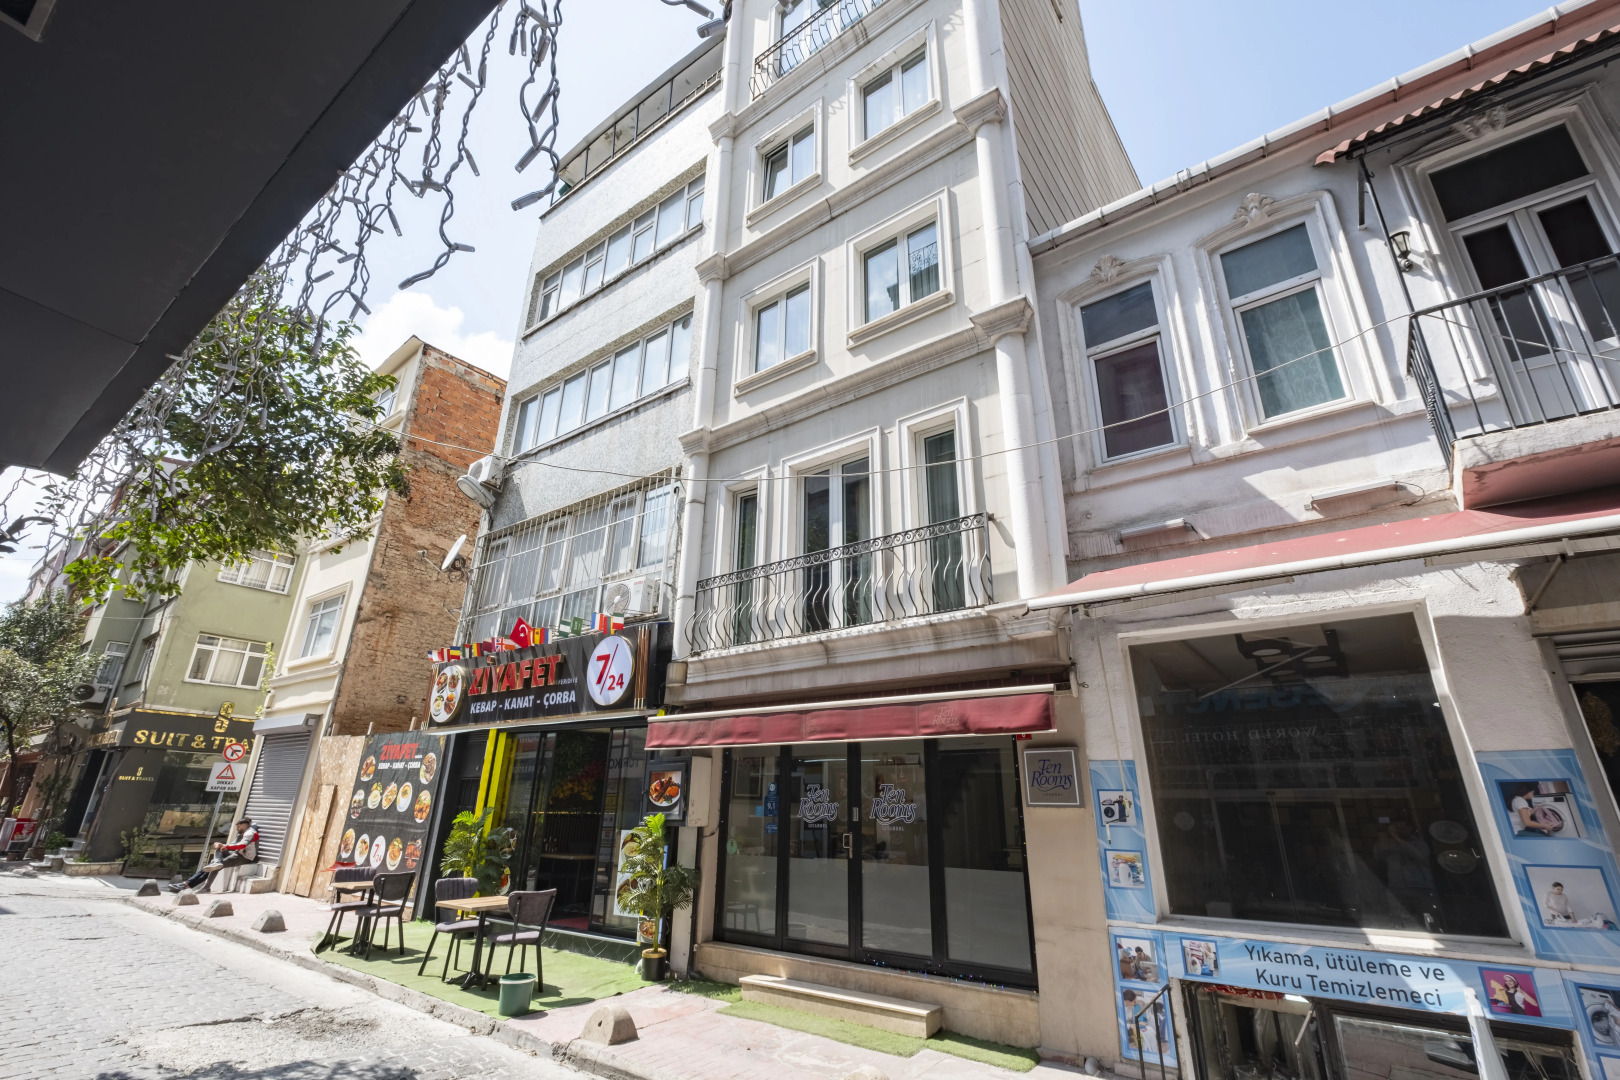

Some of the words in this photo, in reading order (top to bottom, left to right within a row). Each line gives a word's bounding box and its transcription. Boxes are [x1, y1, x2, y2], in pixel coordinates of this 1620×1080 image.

[468, 654, 563, 696] ZİYAFET
[596, 644, 625, 695] 7/24
[470, 701, 497, 714] KEBAP
[504, 695, 535, 710] KANAT
[543, 690, 576, 709] ÇORBA
[134, 729, 190, 747] SUIT
[191, 734, 206, 749] &
[1038, 759, 1062, 775] Ten
[806, 783, 830, 803] Ten
[1031, 770, 1073, 792] Rooms
[878, 784, 906, 804] Ten
[797, 797, 840, 823] Rooms
[868, 798, 917, 825] Rooms
[1244, 944, 1320, 971] Yıkama,
[1326, 952, 1412, 978] ütüleme
[1419, 965, 1446, 981] ve
[1256, 968, 1302, 990] Kuru
[1306, 974, 1443, 1007] Temizlemeci
